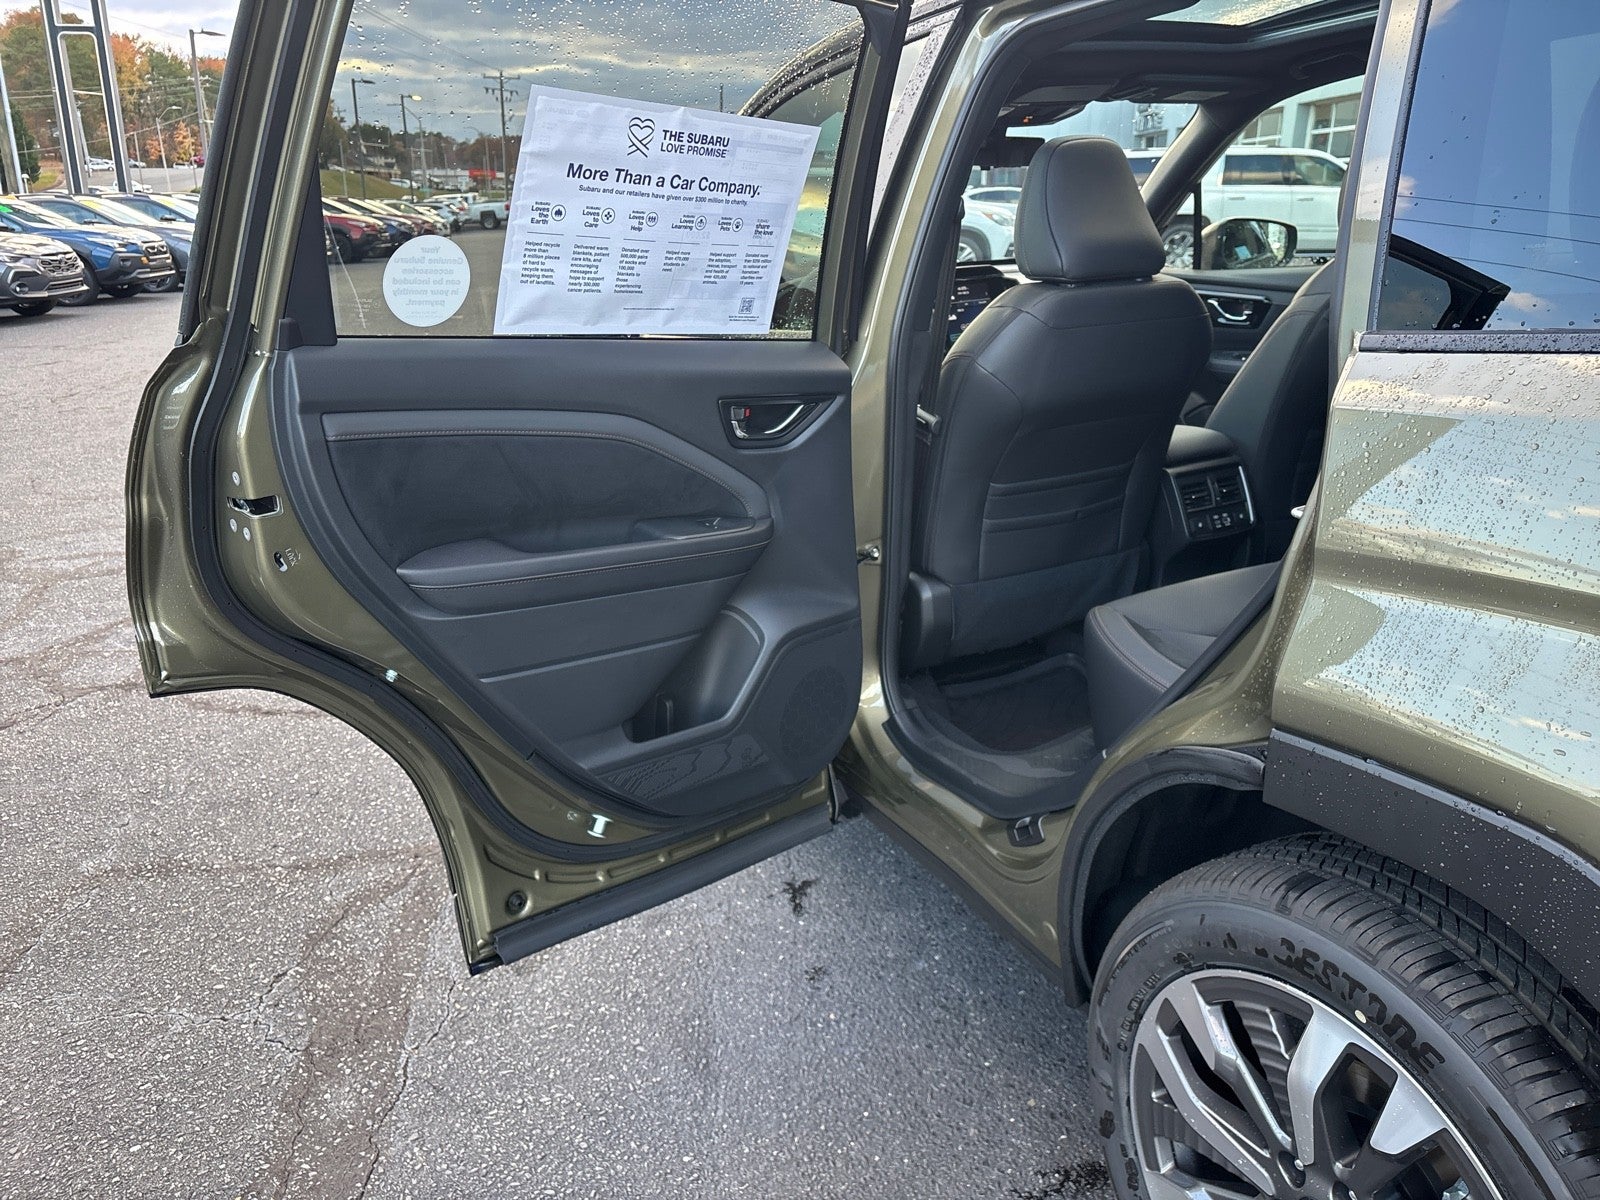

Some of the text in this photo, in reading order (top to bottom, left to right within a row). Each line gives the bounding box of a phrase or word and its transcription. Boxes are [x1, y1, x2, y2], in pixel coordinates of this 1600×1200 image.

[662, 129, 730, 147] THE SUBARU
[660, 142, 727, 158] LOVE PROMISE
[567, 162, 760, 198] More Than a Car Company.
[579, 184, 601, 193] Subaru
[602, 186, 614, 194] and
